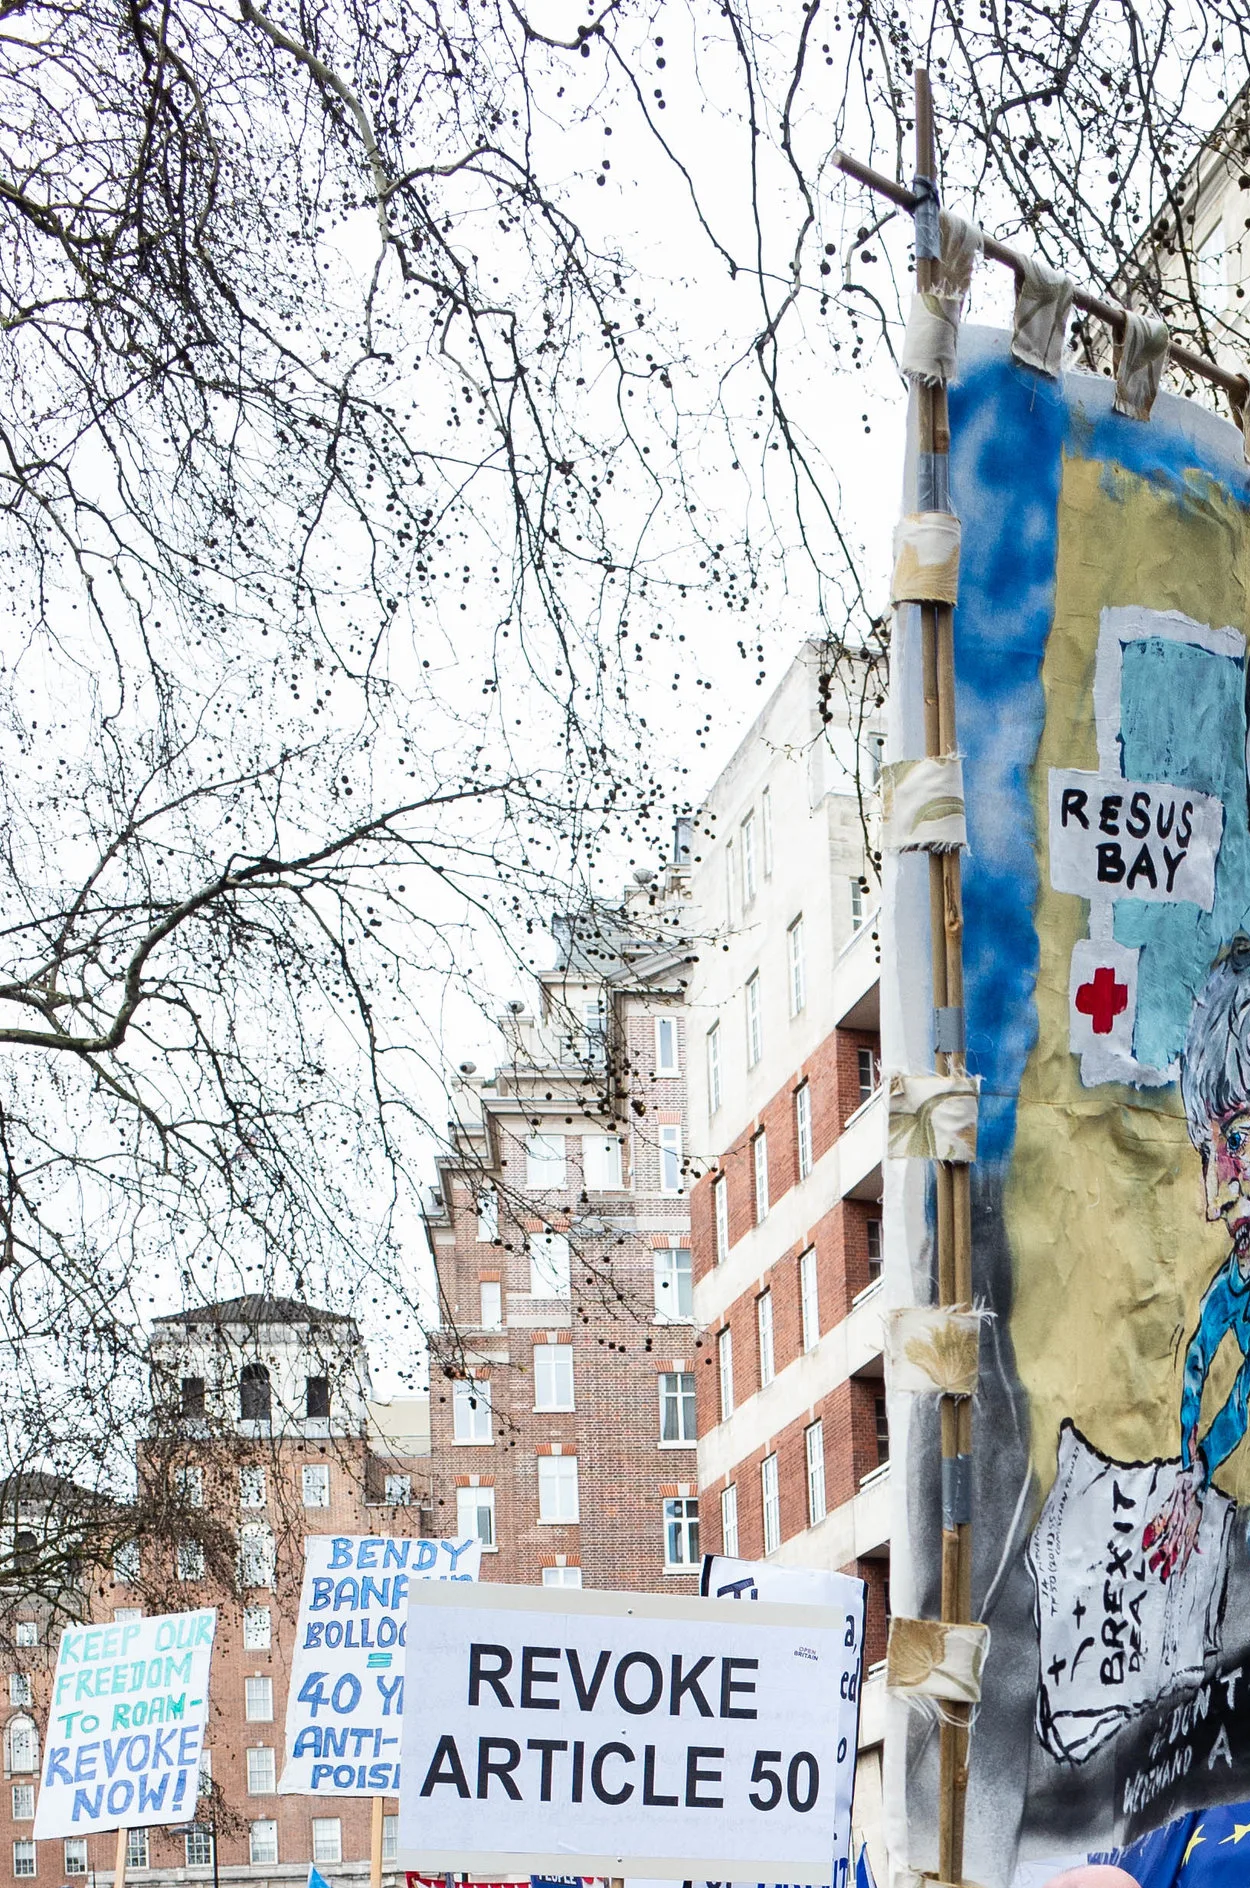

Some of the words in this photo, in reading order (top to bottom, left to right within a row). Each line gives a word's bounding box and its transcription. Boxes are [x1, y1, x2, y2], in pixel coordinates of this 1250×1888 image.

[1061, 788, 1194, 848] RESUS
[1095, 842, 1187, 893] BAY
[327, 1537, 474, 1571] BENDY
[1101, 1480, 1136, 1685] BREXIT
[60, 1624, 141, 1665] KEEP
[155, 1615, 213, 1651] OUR
[1128, 1558, 1147, 1672] DEAL
[55, 1651, 193, 1706] FREEDOM
[297, 1671, 362, 1718] 40
[468, 1643, 759, 1720] REVOKE
[45, 1724, 200, 1787] REVOKE
[419, 1734, 725, 1809] ARTICLE
[748, 1750, 820, 1813] 50
[1208, 1723, 1233, 1771] A
[71, 1769, 188, 1822] NOW!
